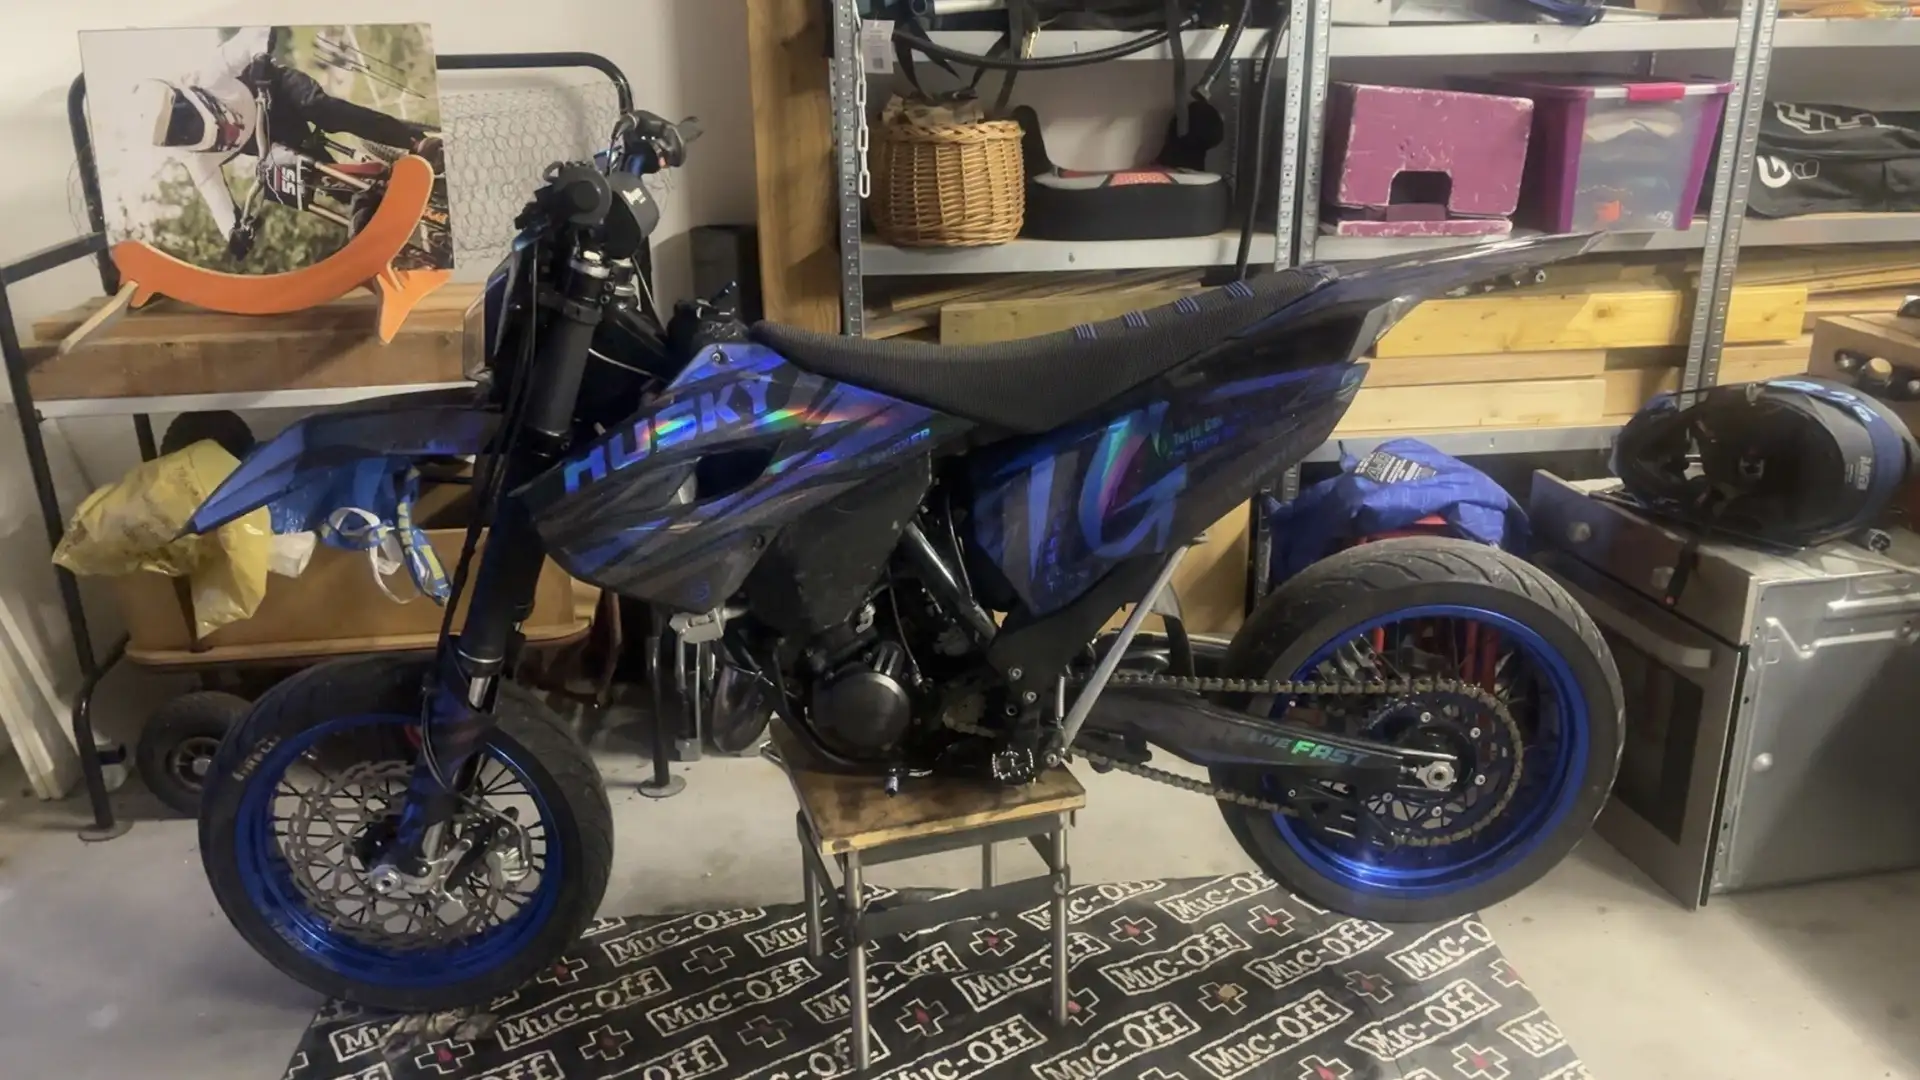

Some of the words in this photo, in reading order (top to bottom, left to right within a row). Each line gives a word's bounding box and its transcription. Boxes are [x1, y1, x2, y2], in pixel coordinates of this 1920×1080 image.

[564, 373, 774, 494] HUSKY
[1291, 740, 1370, 767] FAST
[1166, 869, 1276, 919] Muc-Of
[1110, 926, 1240, 989] Muc-Off
[1256, 919, 1382, 983] Muc-Off
[502, 971, 660, 1044] Muc-Off
[657, 962, 811, 1030] Muc-Off
[1358, 983, 1489, 1055] Muc-Off
[1201, 996, 1341, 1075] Muc-Off
